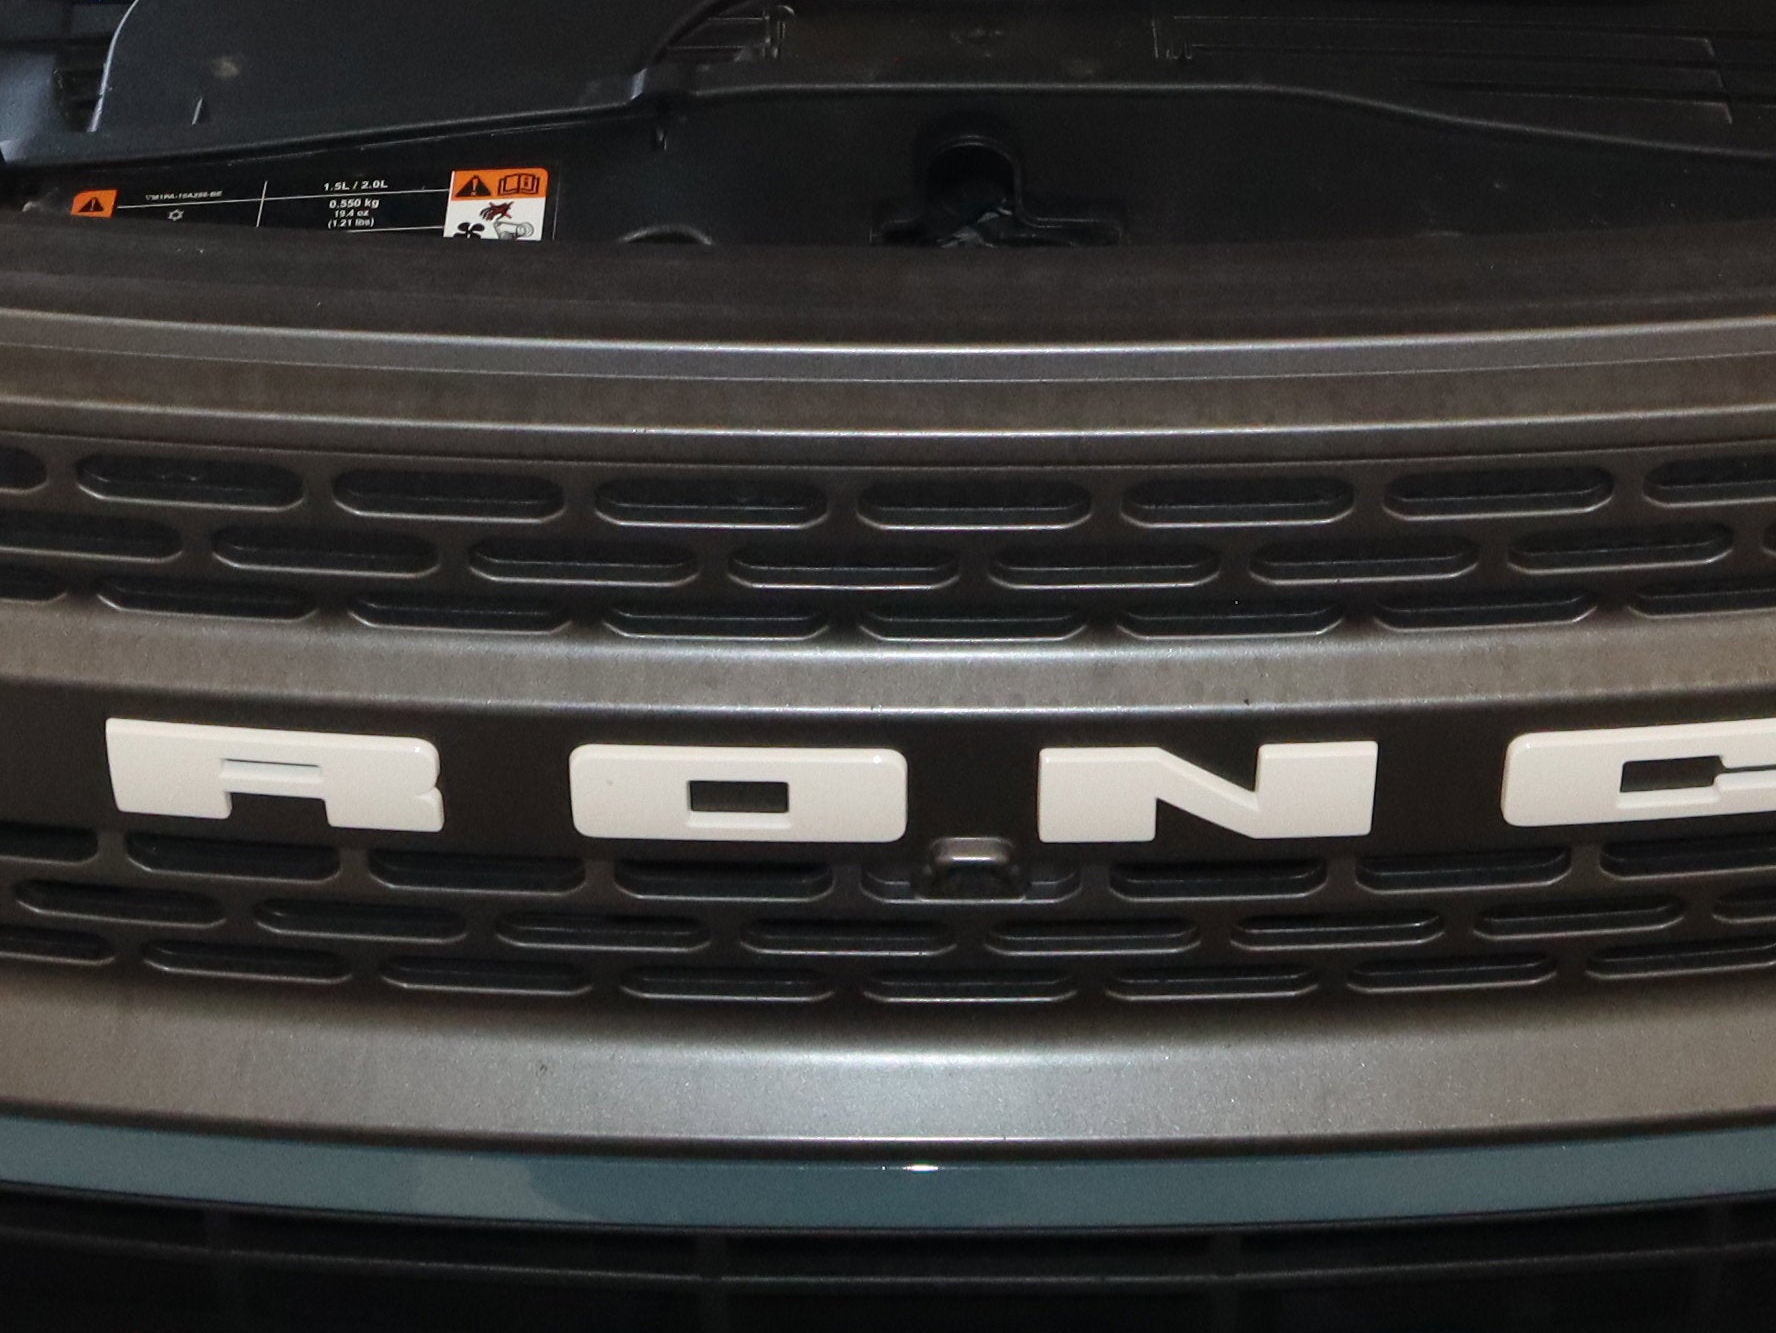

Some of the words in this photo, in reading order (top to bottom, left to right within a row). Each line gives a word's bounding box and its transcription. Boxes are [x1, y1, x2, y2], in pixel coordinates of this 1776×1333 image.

[324, 182, 350, 192] 1.5L
[360, 180, 389, 190] 2.0L
[328, 199, 362, 209] 0.550
[363, 198, 380, 209] kg
